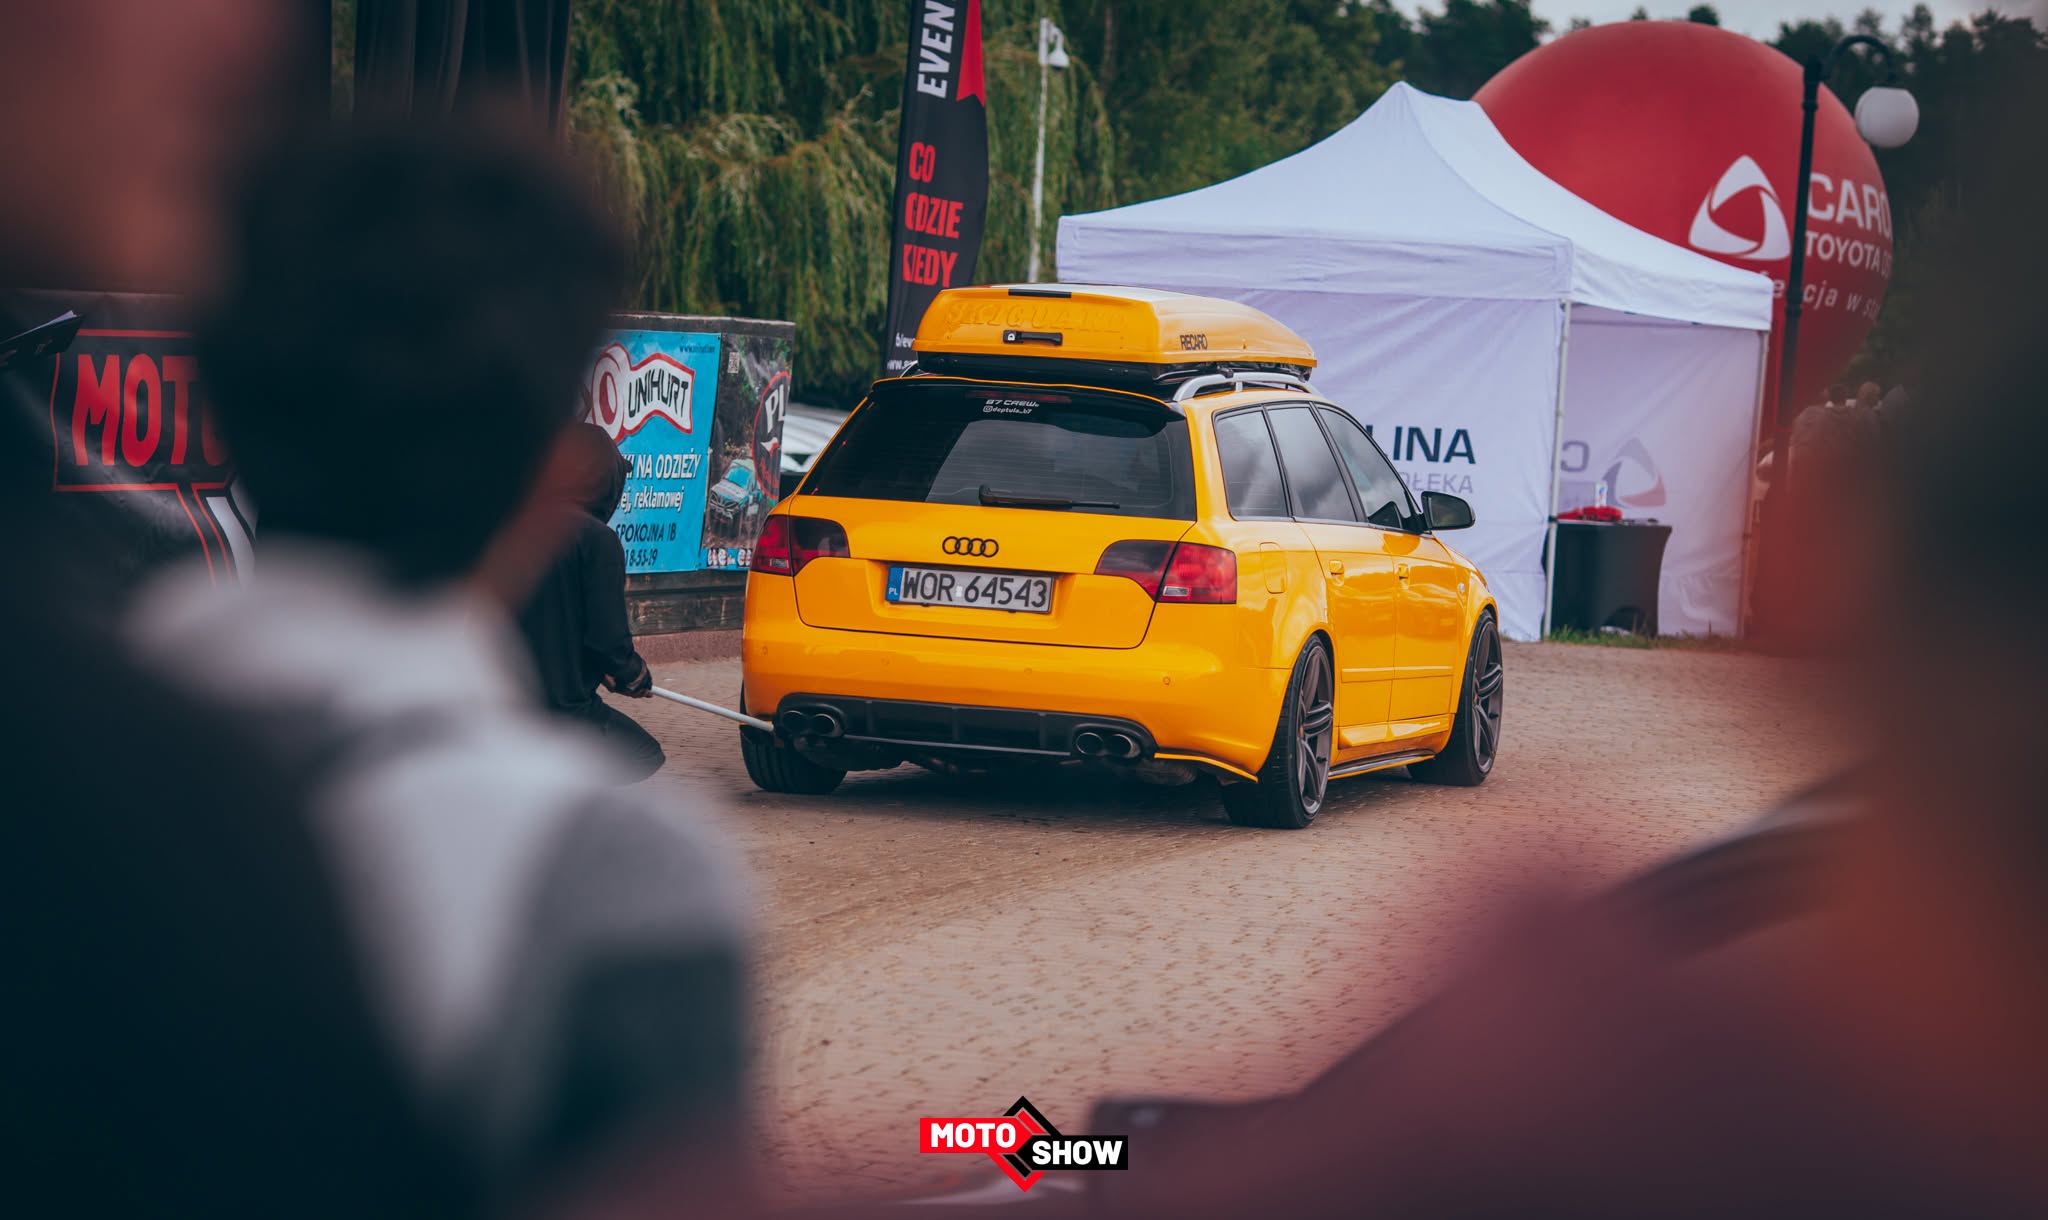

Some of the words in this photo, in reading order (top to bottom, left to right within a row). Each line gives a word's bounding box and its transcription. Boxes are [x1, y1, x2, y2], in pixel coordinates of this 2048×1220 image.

[917, 0, 955, 98] EVEN
[909, 142, 936, 183] CO
[903, 244, 958, 288] KIEDY
[1806, 230, 1880, 273] TOYOTA
[1180, 334, 1208, 351] RECARO
[628, 369, 688, 418] UNIHURT
[636, 454, 653, 478] NA
[655, 447, 702, 479] ODZIEŻY
[1366, 424, 1476, 465] INA
[634, 485, 684, 512] reklamowej
[616, 523, 665, 542] SPOKOJNA
[888, 587, 898, 597] PL
[903, 571, 955, 601] WOR
[964, 576, 1048, 608] 64543
